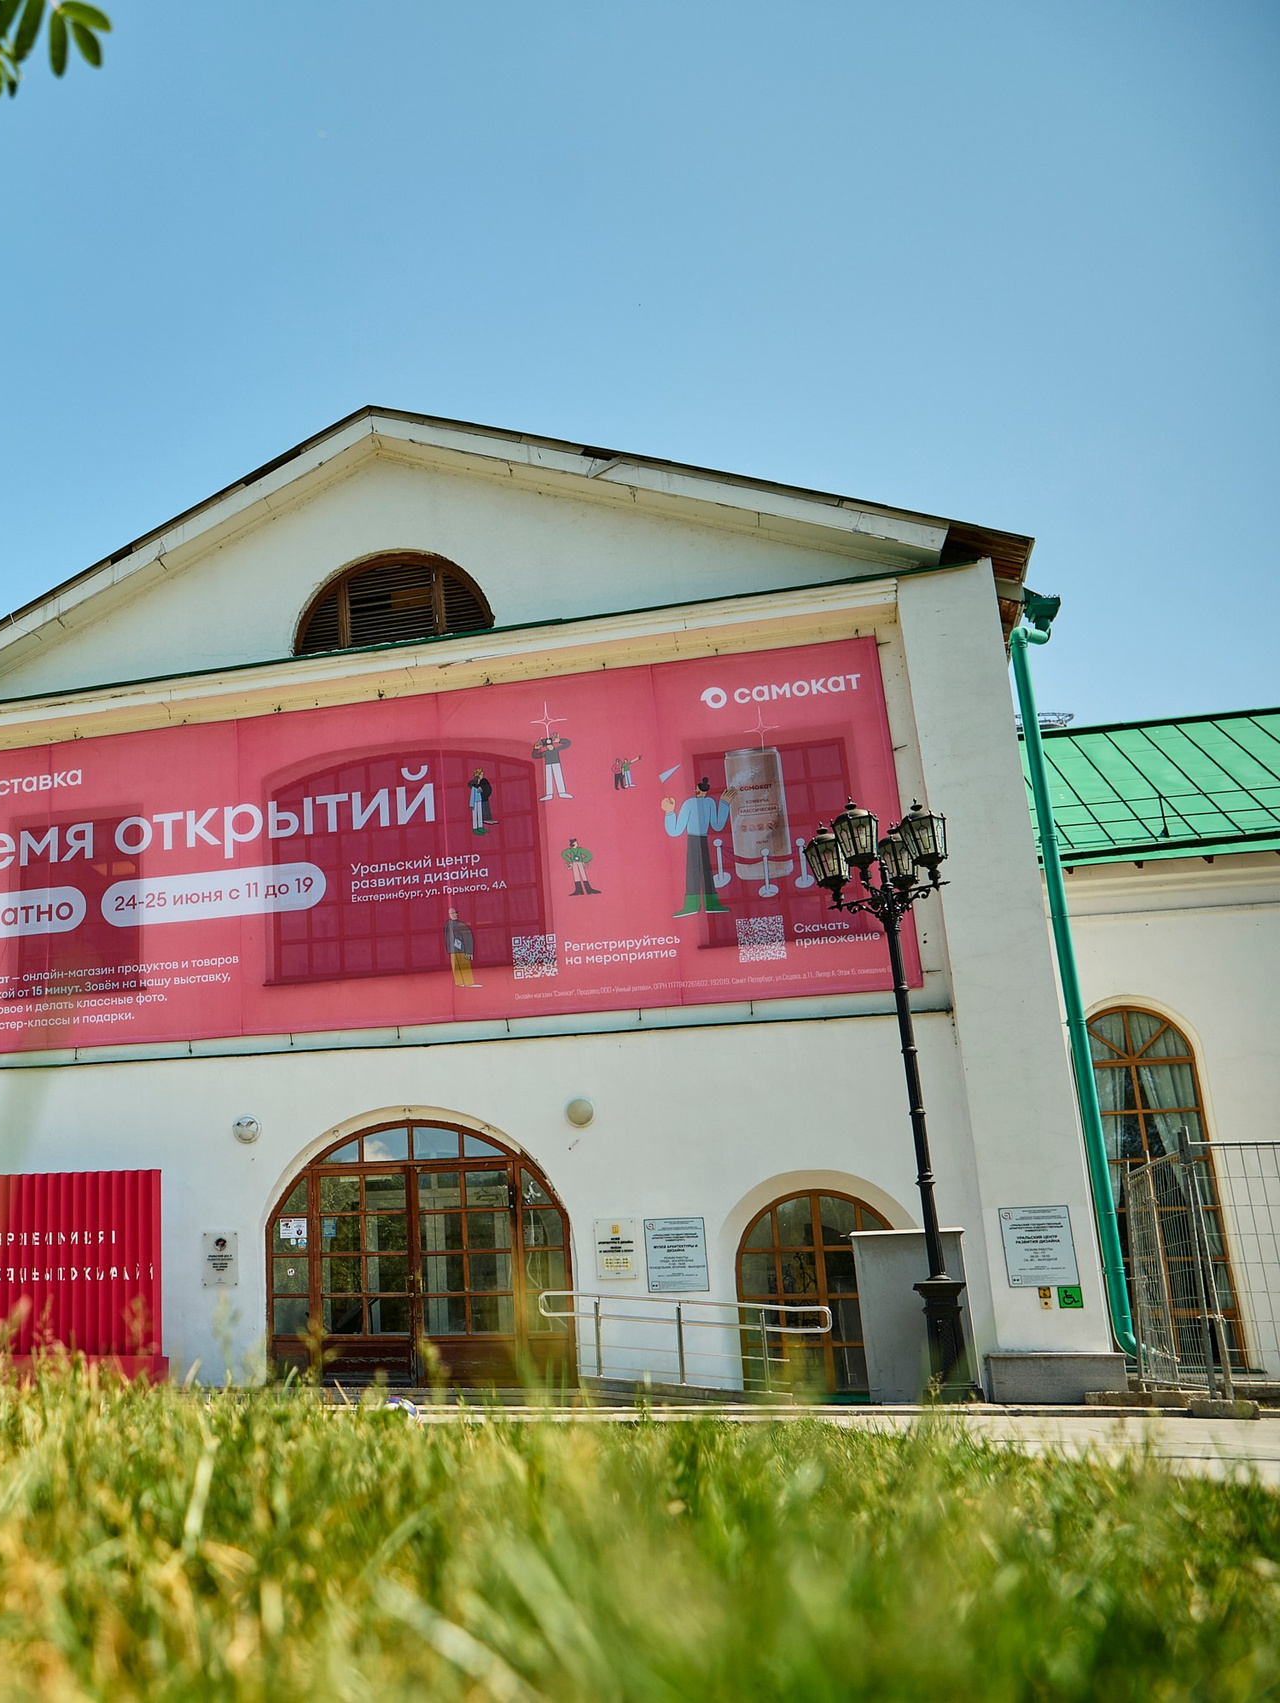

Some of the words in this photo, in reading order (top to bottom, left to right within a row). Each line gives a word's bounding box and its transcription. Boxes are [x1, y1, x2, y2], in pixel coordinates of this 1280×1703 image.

[734, 672, 861, 704] самокат
[114, 764, 435, 859] открытий
[351, 855, 432, 877] Уральский
[436, 853, 480, 868] центр
[351, 874, 420, 892] развития
[424, 866, 489, 884] дизайна
[114, 889, 168, 912] 24-25
[172, 888, 223, 908] июня
[229, 888, 240, 900] с
[245, 882, 258, 899] 11
[264, 883, 290, 899] до
[294, 876, 314, 894] 19
[351, 888, 424, 903] Екатеринбург,
[425, 888, 440, 898] ул.
[443, 883, 490, 895] Горького,
[492, 880, 507, 889] 4А
[794, 921, 850, 933] Скачать
[564, 934, 680, 952] Регистрируйтесь
[795, 931, 881, 948] приложение
[22, 966, 115, 982] онлайн-магазин
[117, 961, 178, 975] продуктов
[181, 961, 189, 969] и
[191, 955, 239, 968] товаров
[565, 956, 582, 965] на
[586, 949, 677, 965] мероприятие
[17, 989, 29, 997] от
[32, 986, 43, 996] 15
[44, 984, 82, 996] минут.
[85, 980, 120, 992] Зовём
[122, 979, 137, 989] на
[139, 976, 171, 989] нашу
[173, 971, 231, 985] выставку,
[600, 986, 611, 994] ООО
[26, 1003, 33, 1012] и
[35, 1000, 74, 1013] делать
[76, 996, 133, 1009] классные
[135, 992, 168, 1006] фото.
[72, 1016, 79, 1024] и
[82, 1011, 135, 1024] подарки.
